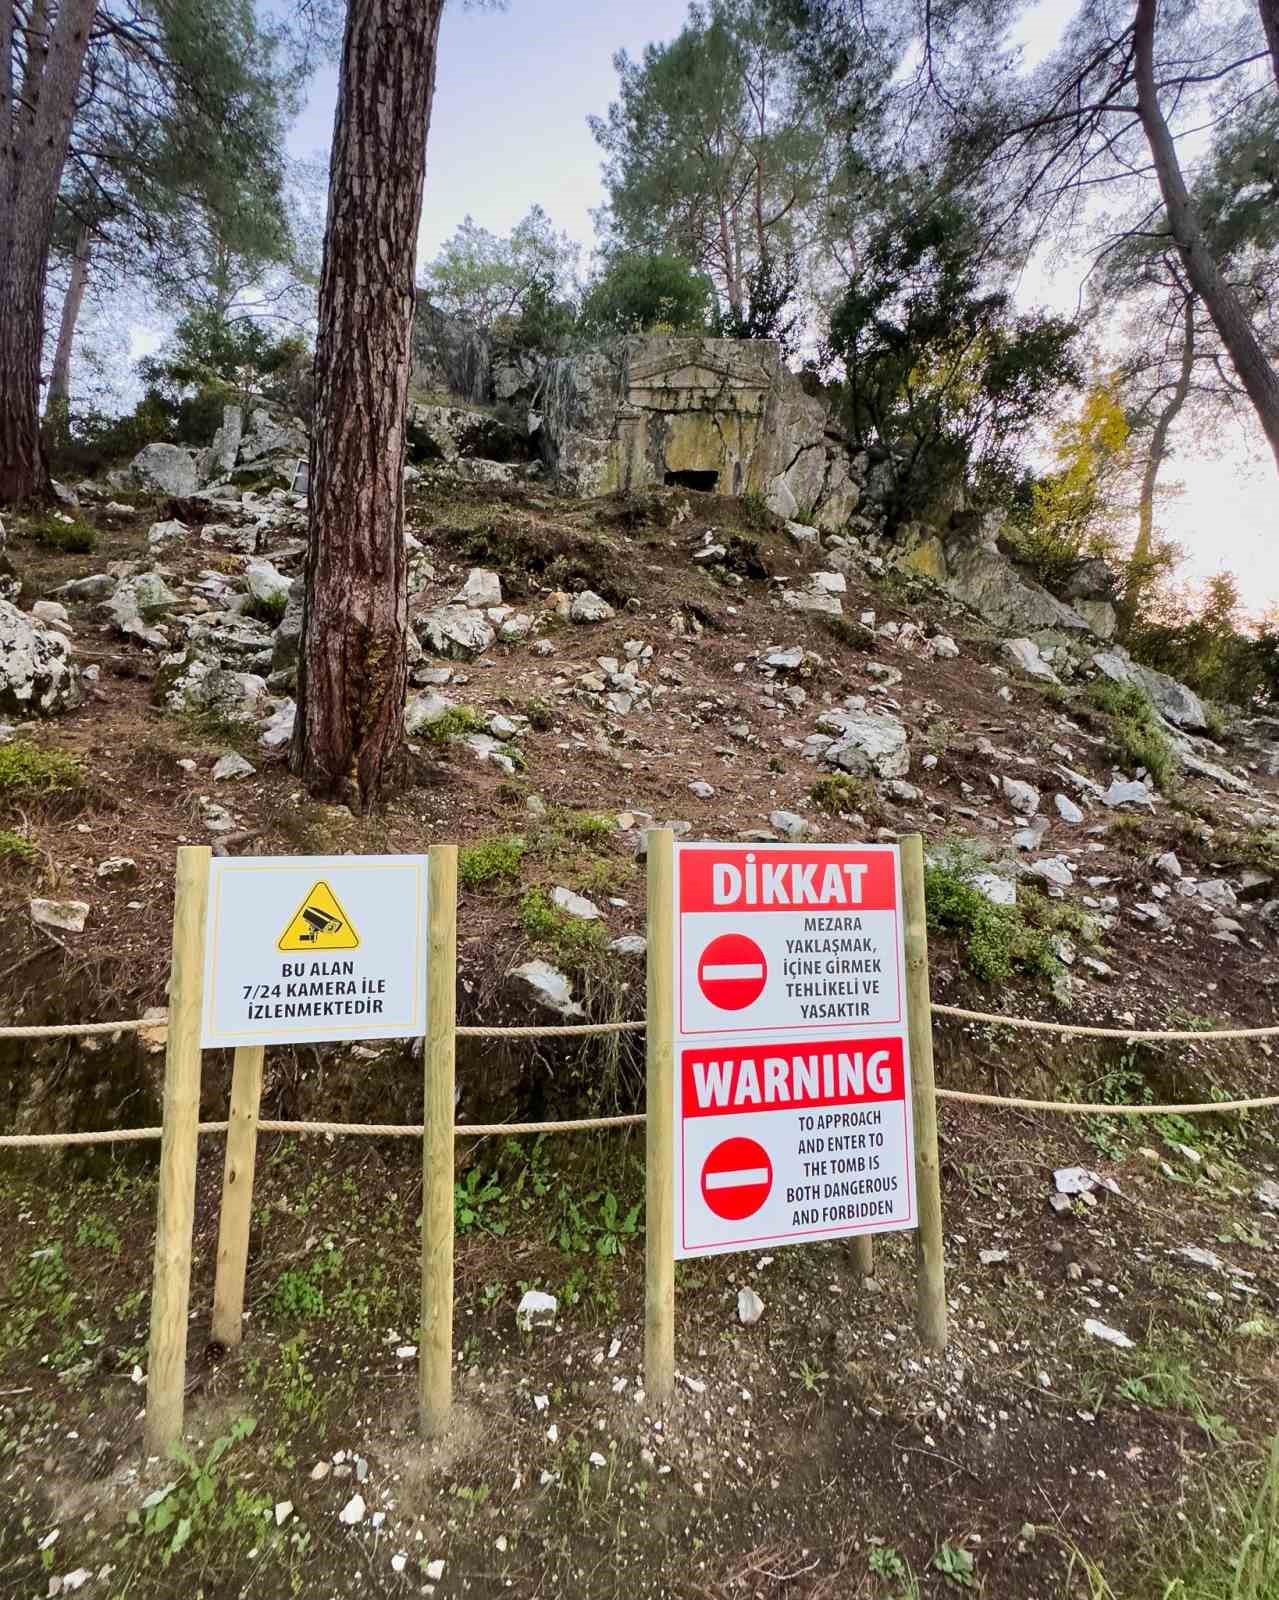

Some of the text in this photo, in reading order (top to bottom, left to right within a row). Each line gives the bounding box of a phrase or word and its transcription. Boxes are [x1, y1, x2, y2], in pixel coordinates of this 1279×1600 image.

[713, 853, 868, 905] DİKKAT
[805, 917, 862, 931] MEZARA
[786, 938, 876, 956] YAKLAŞMAK,
[282, 962, 354, 977] BU ALAN
[783, 958, 881, 979] İÇİNE GİRMEK
[243, 977, 385, 1000] 7/24 KAMERA İLE
[786, 978, 879, 997] TEHLİKELİ VE
[248, 997, 383, 1019] İZLENMEKTEDİR
[801, 1003, 870, 1019] YASAKTIR
[693, 1050, 892, 1108] WARNING
[799, 1111, 881, 1131] TO APPROACH
[798, 1133, 883, 1154] AND ENTER TO
[804, 1156, 879, 1177] THE TOMB IS
[787, 1177, 897, 1202] BOTH DANGEROUS
[792, 1200, 893, 1225] AND FORBIDDEN
